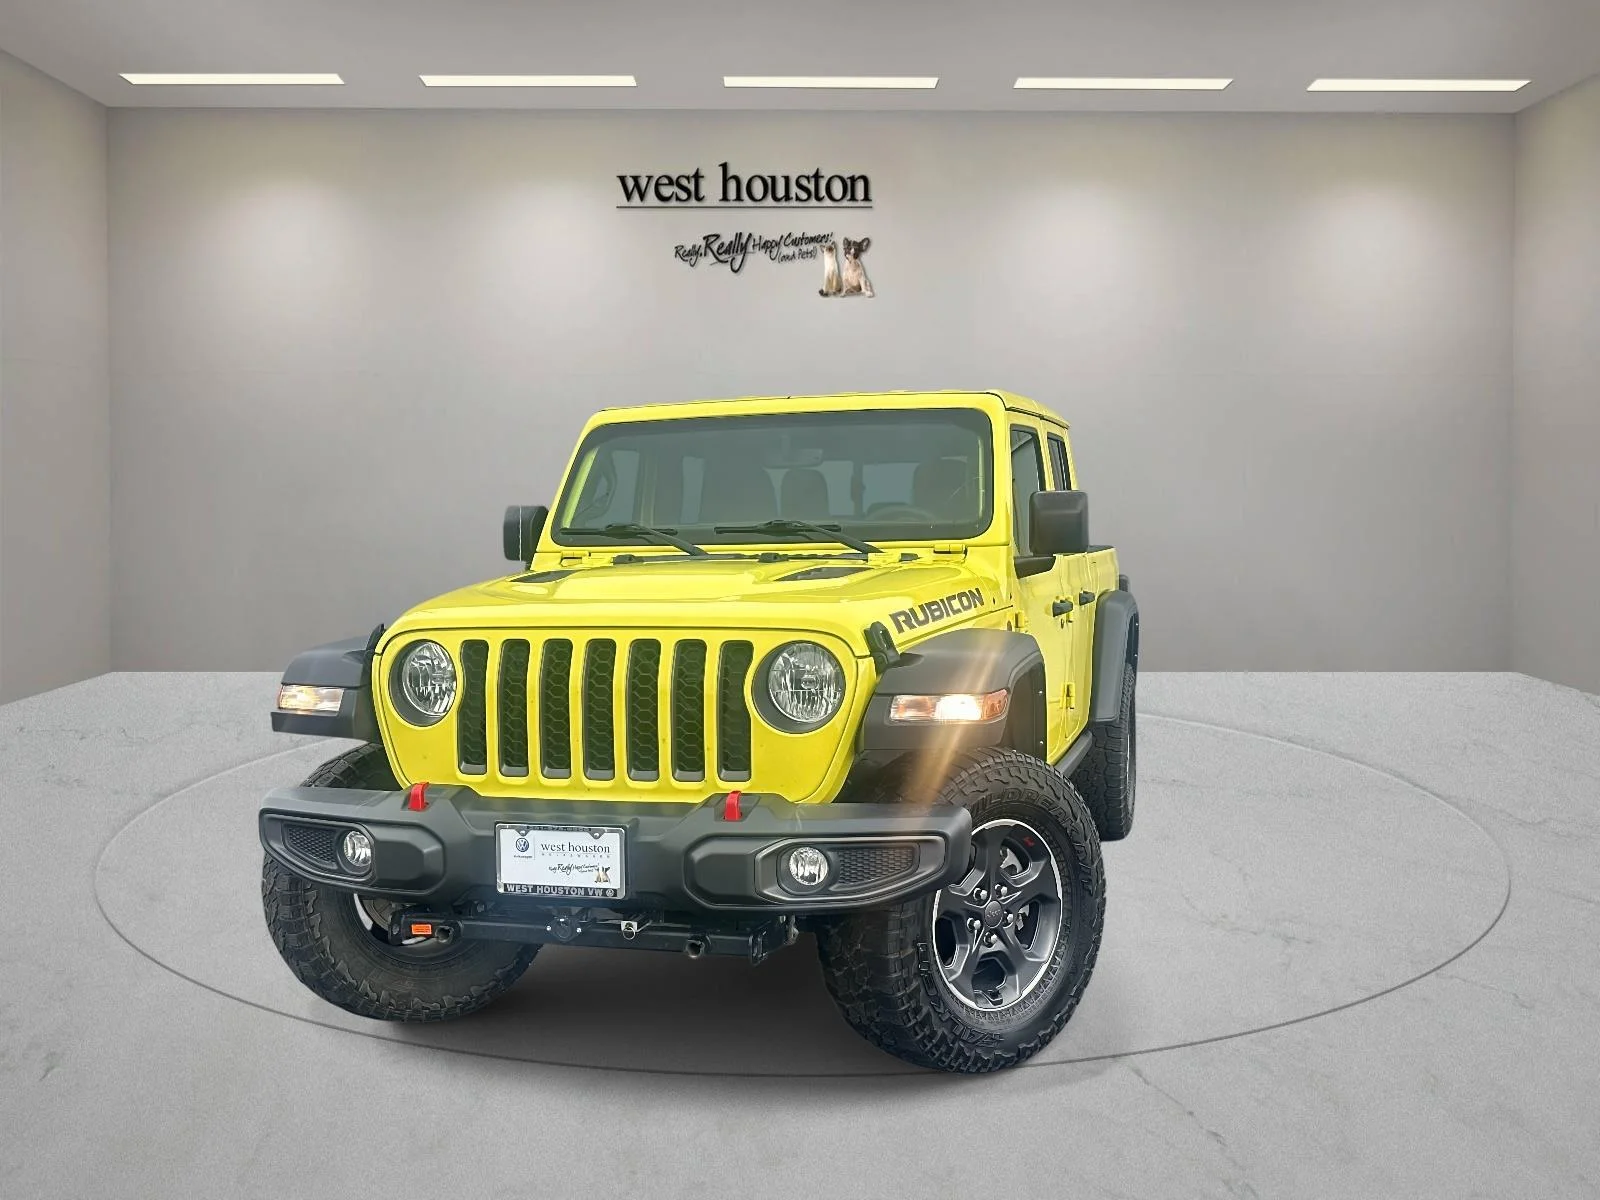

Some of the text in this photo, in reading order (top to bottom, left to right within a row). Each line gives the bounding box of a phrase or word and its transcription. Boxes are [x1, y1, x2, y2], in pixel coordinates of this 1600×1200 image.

[617, 162, 873, 203] west houston
[703, 231, 753, 274] Really
[752, 235, 783, 261] Happy
[783, 231, 834, 248] Customers!
[889, 587, 985, 634] RUBICON
[540, 841, 611, 854] west houston
[506, 884, 603, 897] WEST HOUSTON VW
